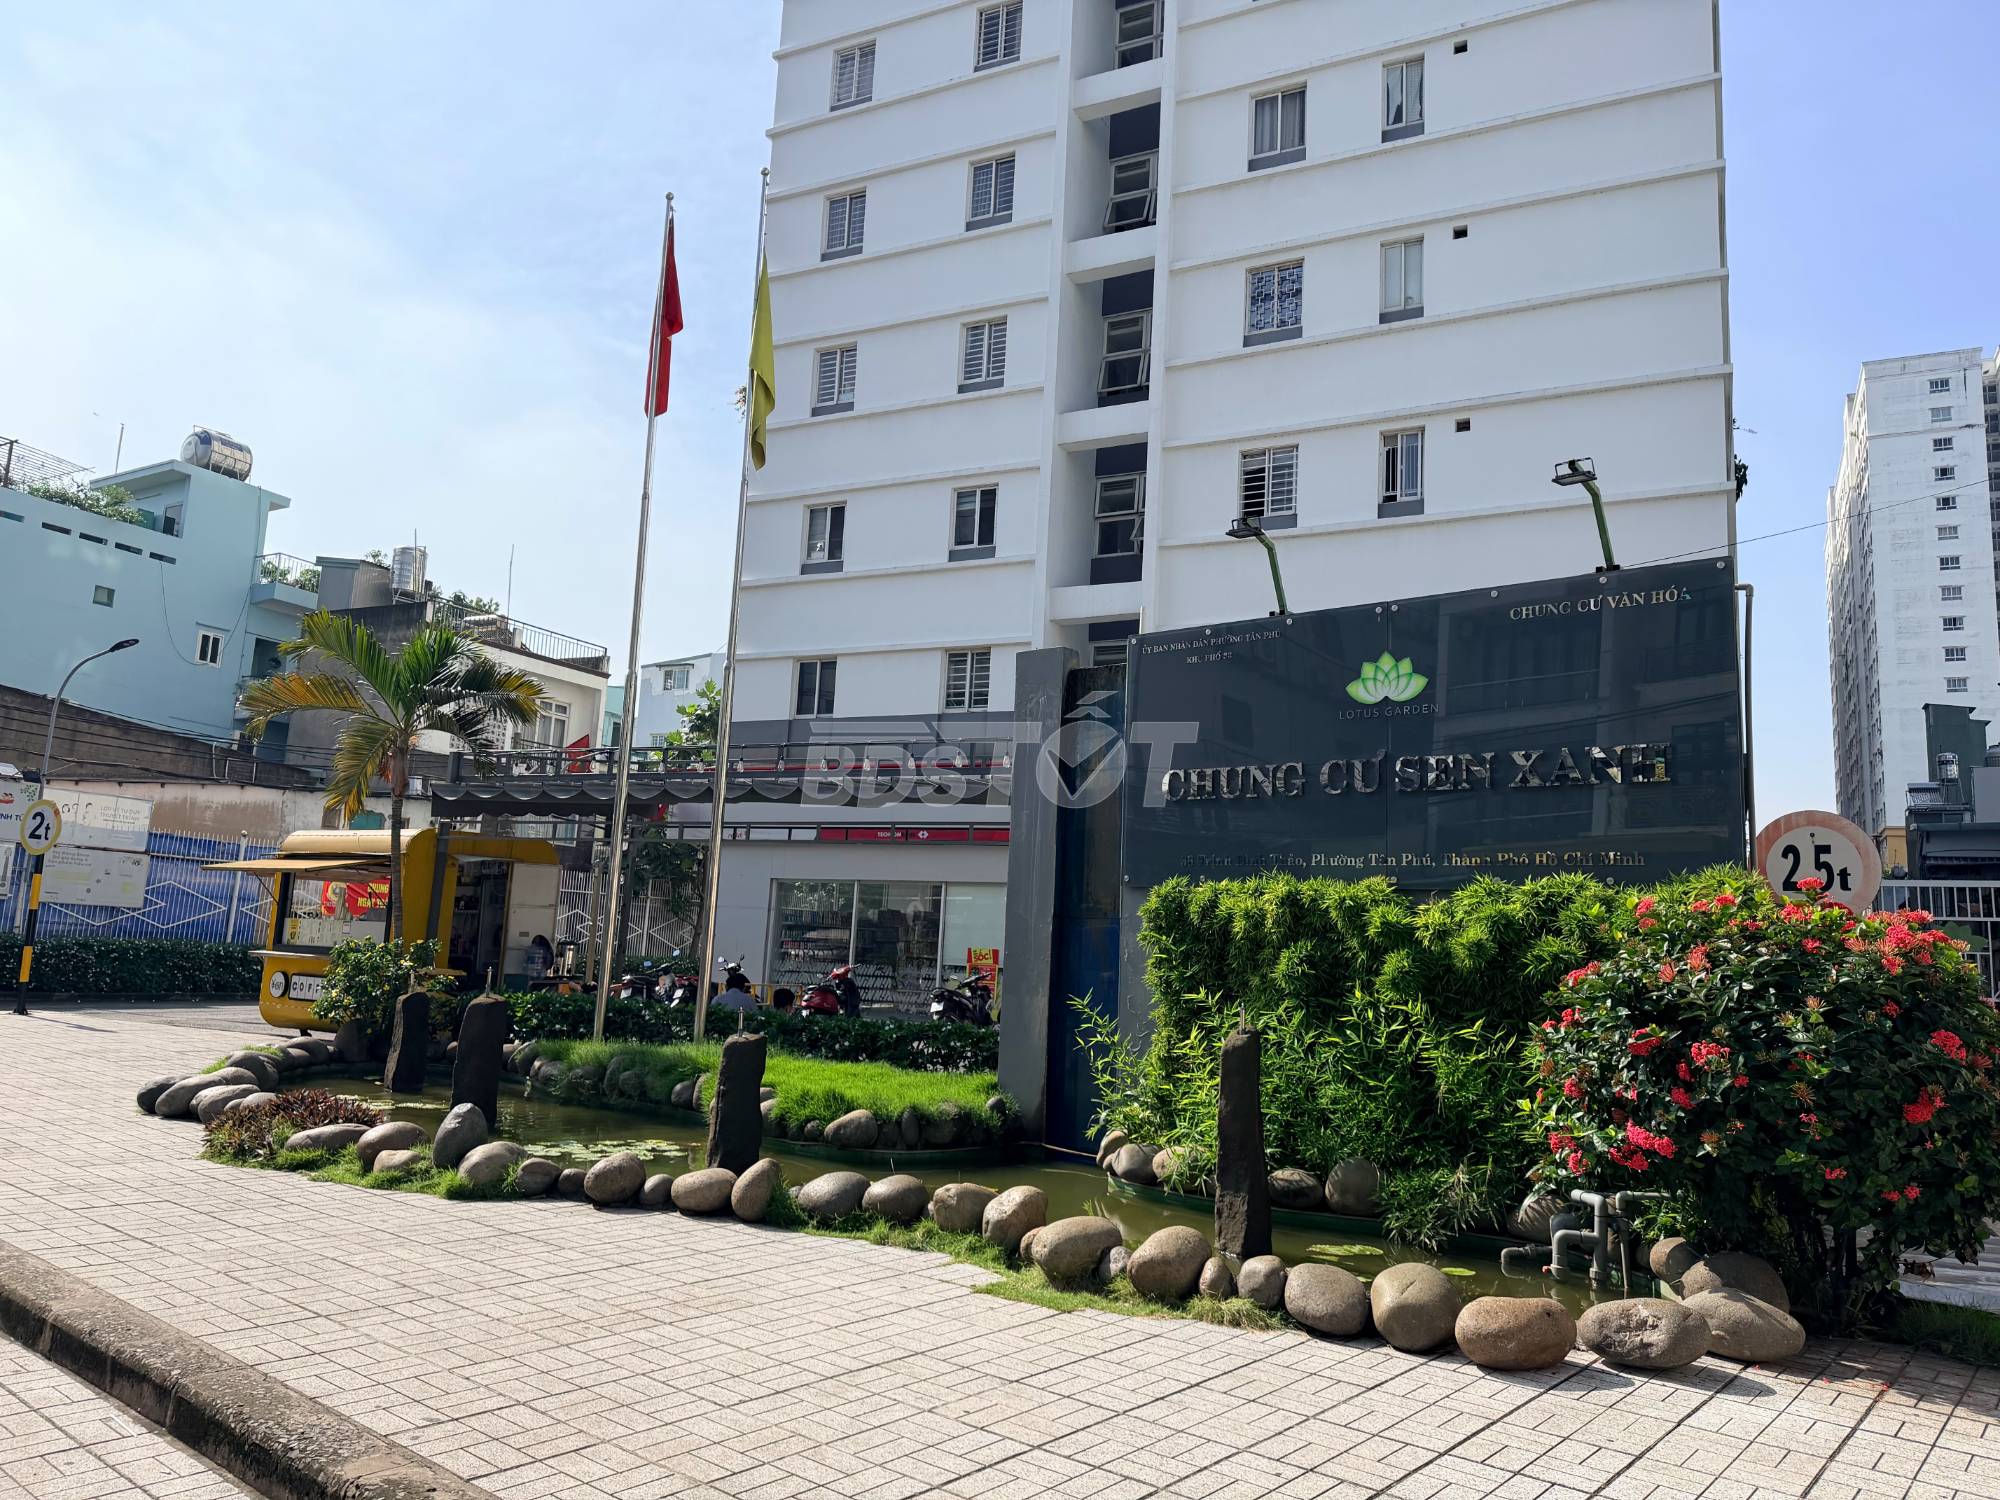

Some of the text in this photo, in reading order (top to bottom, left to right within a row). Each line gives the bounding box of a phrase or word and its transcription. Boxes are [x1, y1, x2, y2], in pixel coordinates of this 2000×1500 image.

[1509, 584, 1693, 620] CHUNG CƯ VĂN HÓA
[1153, 644, 1168, 653] BAN
[1170, 641, 1191, 652] NHÂN
[1193, 637, 1209, 649] DÂN
[1210, 634, 1243, 647] PHƯỜNG
[1245, 630, 1261, 642] TÂN
[1186, 654, 1202, 664] KHU
[1204, 650, 1221, 662] PHỐ
[1339, 703, 1440, 720] LOTUS GARDEN
[1161, 743, 1672, 801] CHUNG CƯ SEN XANH
[28, 811, 51, 841] 2t
[1311, 851, 1364, 868] Phường
[1368, 852, 1397, 866] Tân
[1401, 851, 1436, 867] Phú,
[1442, 851, 1492, 866] Thành
[1535, 850, 1558, 866] Hồ
[1563, 850, 1593, 866] Chí
[1600, 850, 1646, 866] Minh
